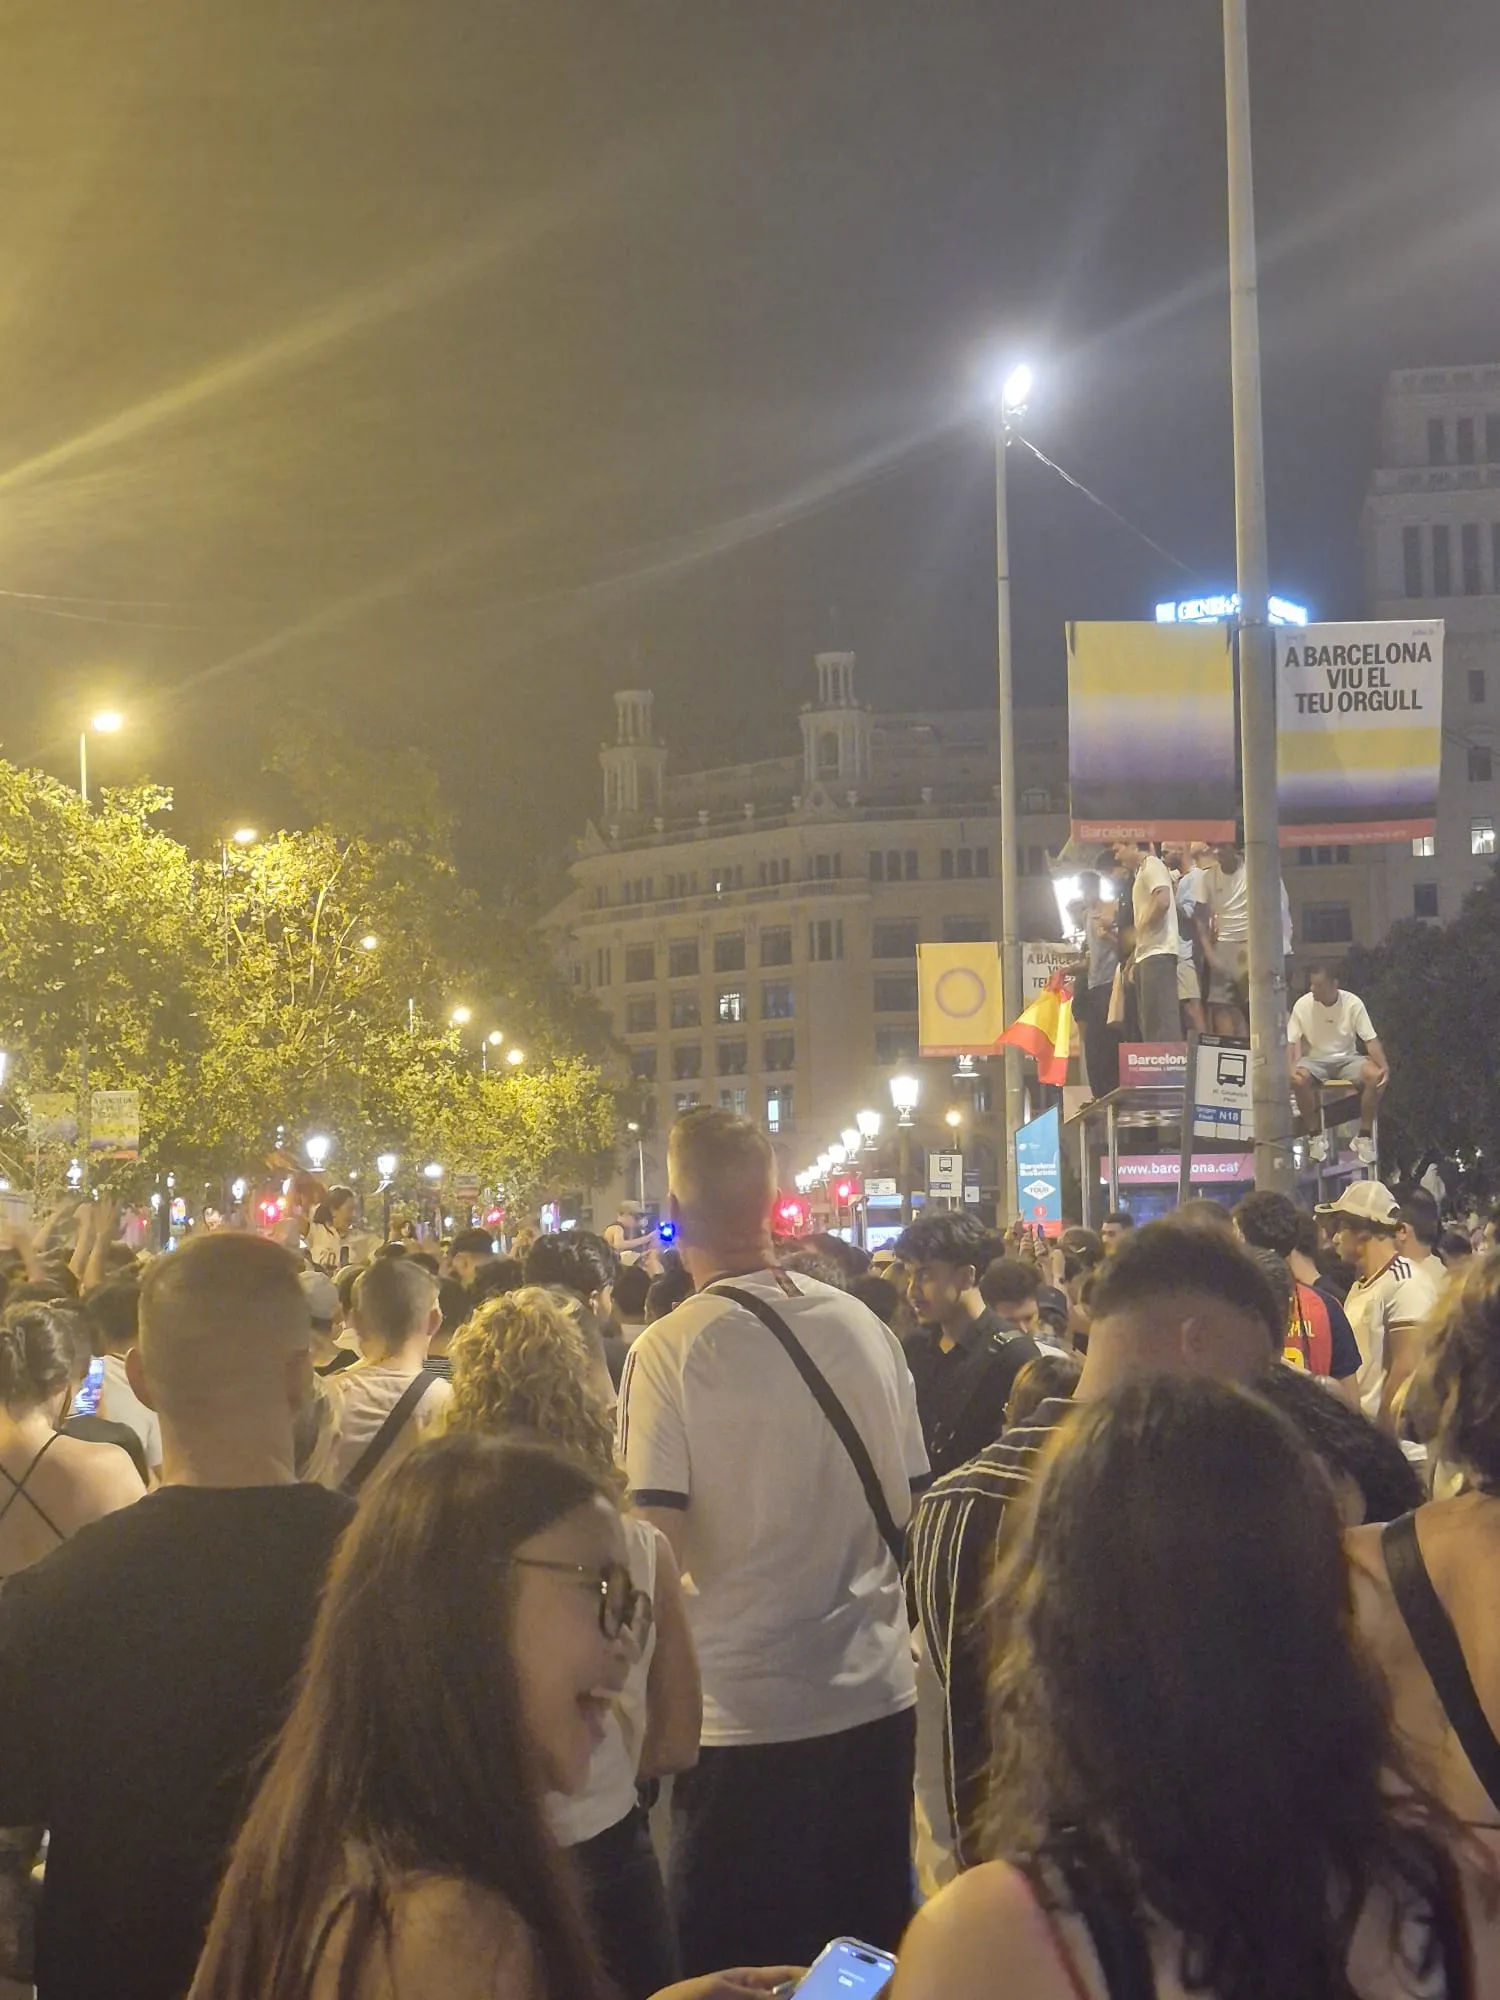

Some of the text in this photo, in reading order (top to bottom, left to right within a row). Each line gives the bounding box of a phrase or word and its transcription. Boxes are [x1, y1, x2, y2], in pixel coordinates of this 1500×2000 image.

[1285, 642, 1432, 667] A BARCELONA
[1326, 667, 1391, 689] VIU EL
[1294, 689, 1423, 714] TEU ORGULL
[1080, 824, 1146, 839] Barcelona
[1027, 953, 1034, 964] A
[1219, 1111, 1239, 1121] N18
[1118, 1161, 1239, 1174] www.barcona.cat
